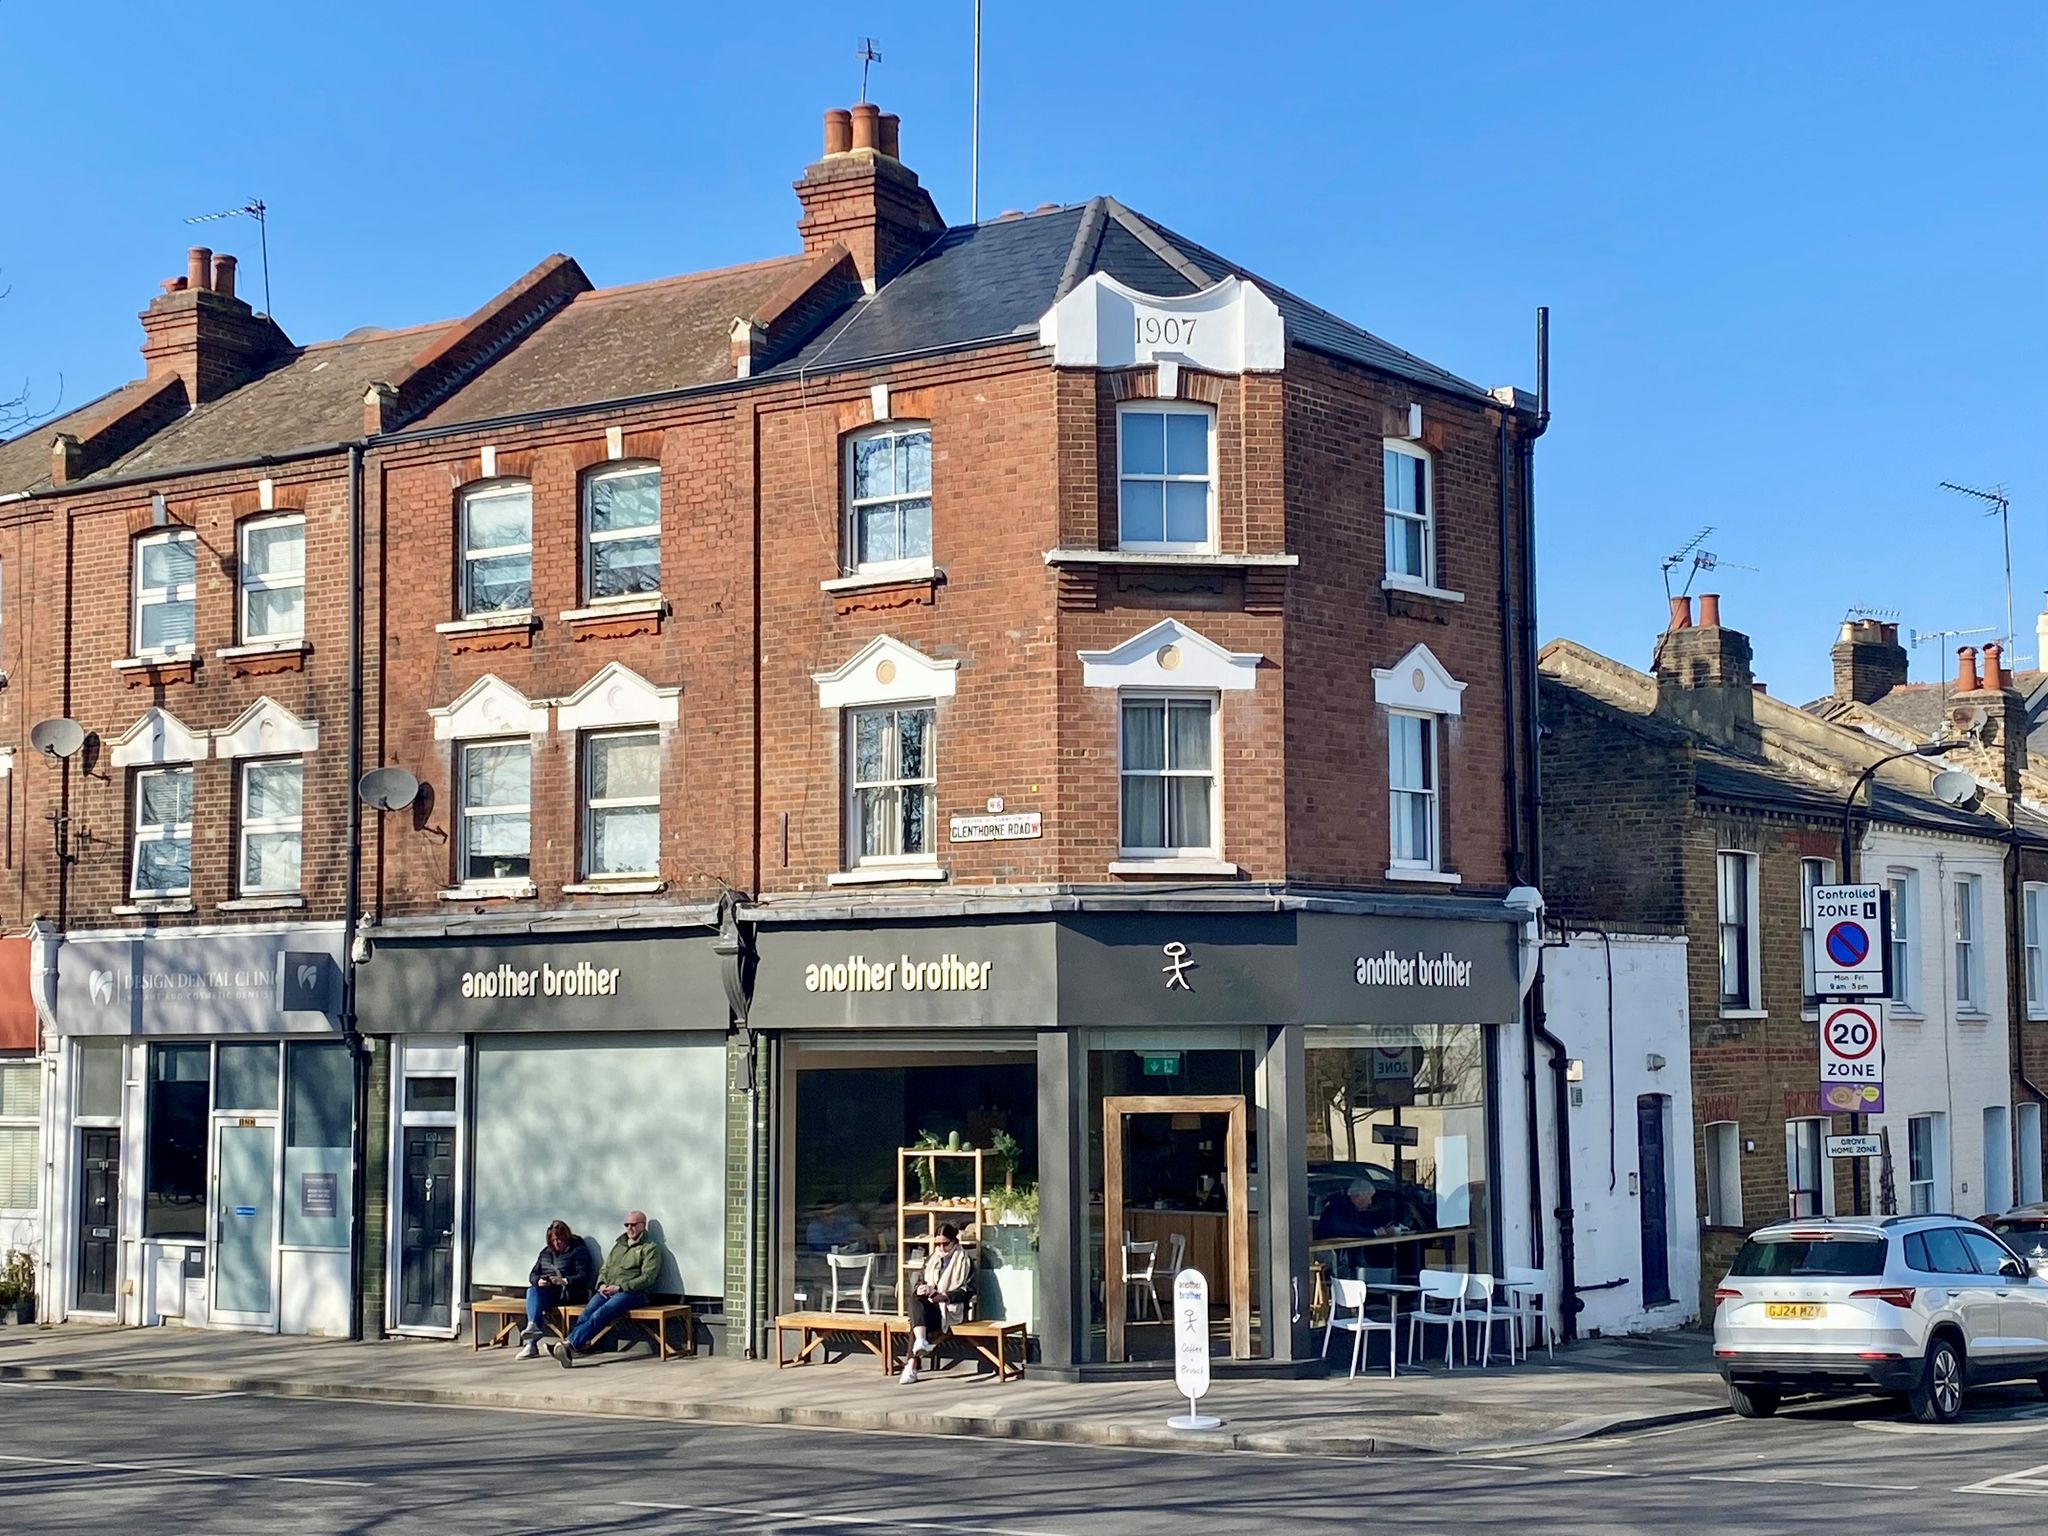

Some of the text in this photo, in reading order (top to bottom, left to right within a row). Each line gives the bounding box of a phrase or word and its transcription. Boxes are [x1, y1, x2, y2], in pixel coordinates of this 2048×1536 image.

[1136, 317, 1198, 345] 1907
[1008, 823, 1031, 836] ROAD
[1817, 889, 1876, 900] Controlled
[1817, 904, 1859, 917] ZONE
[804, 953, 993, 992] another brother
[1355, 950, 1472, 988] another brother
[124, 969, 276, 990] DESIGN DENTAL CLINI
[461, 961, 621, 998] another brother
[1832, 1023, 1869, 1045] 20
[1827, 1063, 1876, 1077] ZONE
[1840, 1137, 1867, 1145] GROVE
[1831, 1145, 1878, 1154] HOME ZONE
[1768, 1305, 1822, 1318] GJ24 MZY
